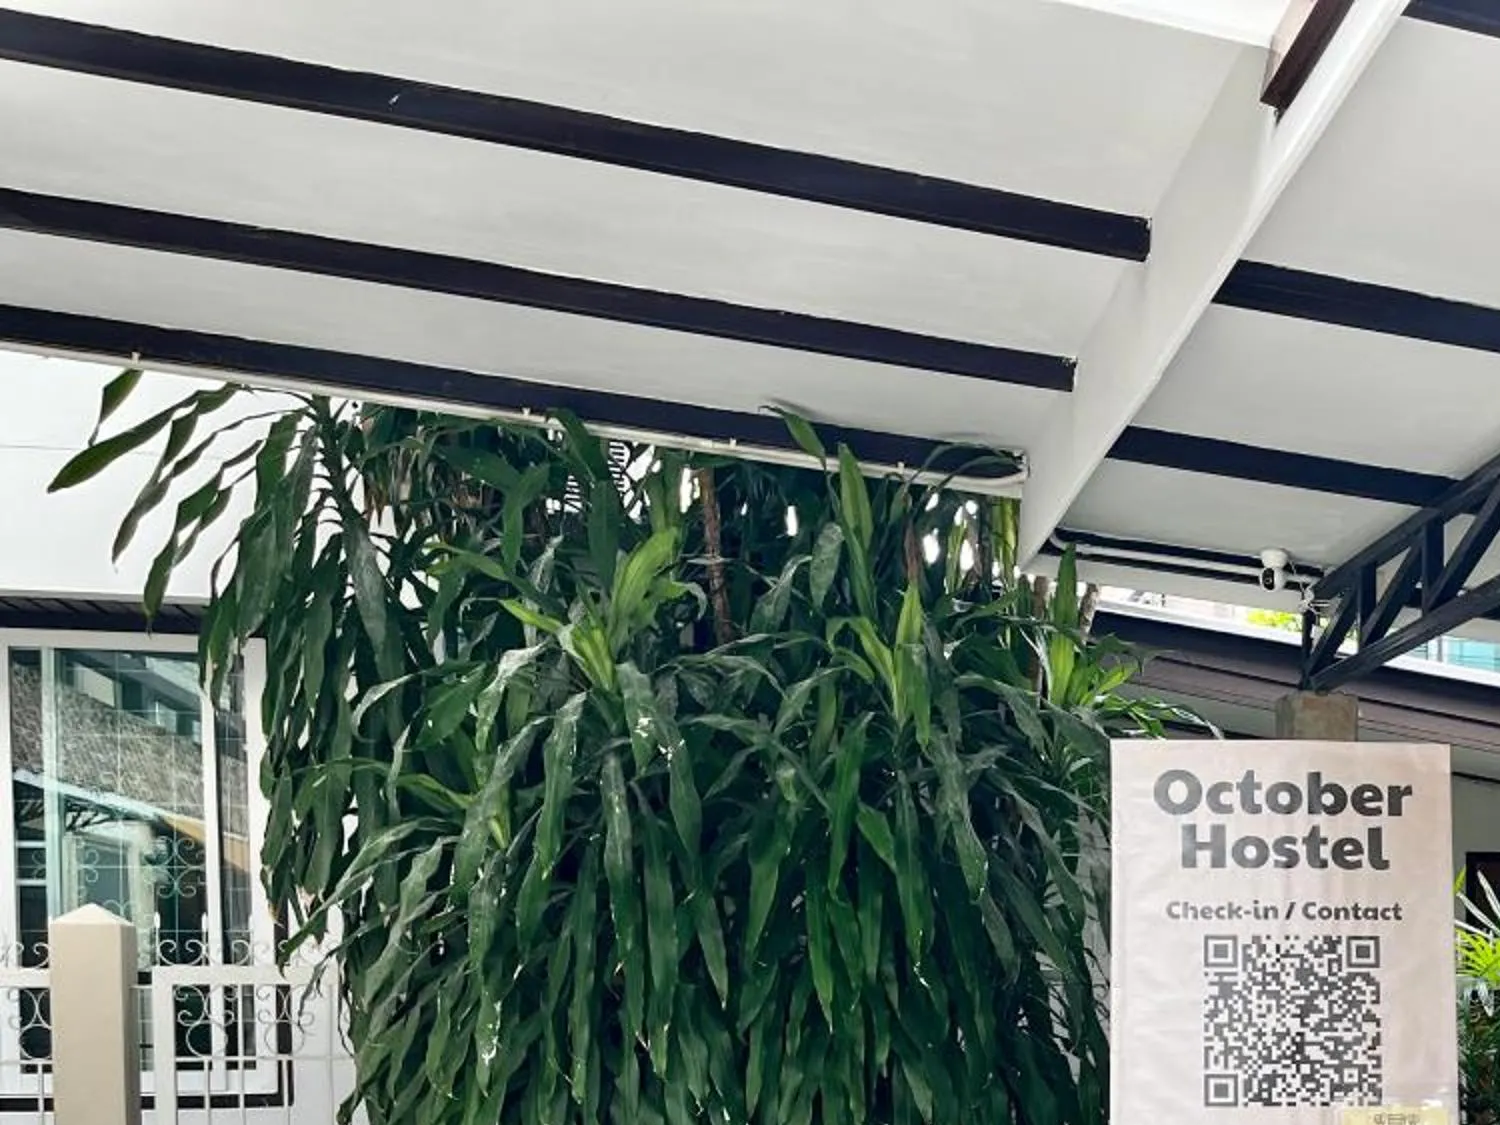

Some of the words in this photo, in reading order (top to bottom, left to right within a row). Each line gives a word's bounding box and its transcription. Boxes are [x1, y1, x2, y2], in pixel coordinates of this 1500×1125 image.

[1153, 769, 1413, 817] October
[1181, 824, 1391, 871] Hostel
[1166, 900, 1279, 921] Check-in
[1284, 902, 1296, 921] /
[1301, 902, 1404, 921] Contact
